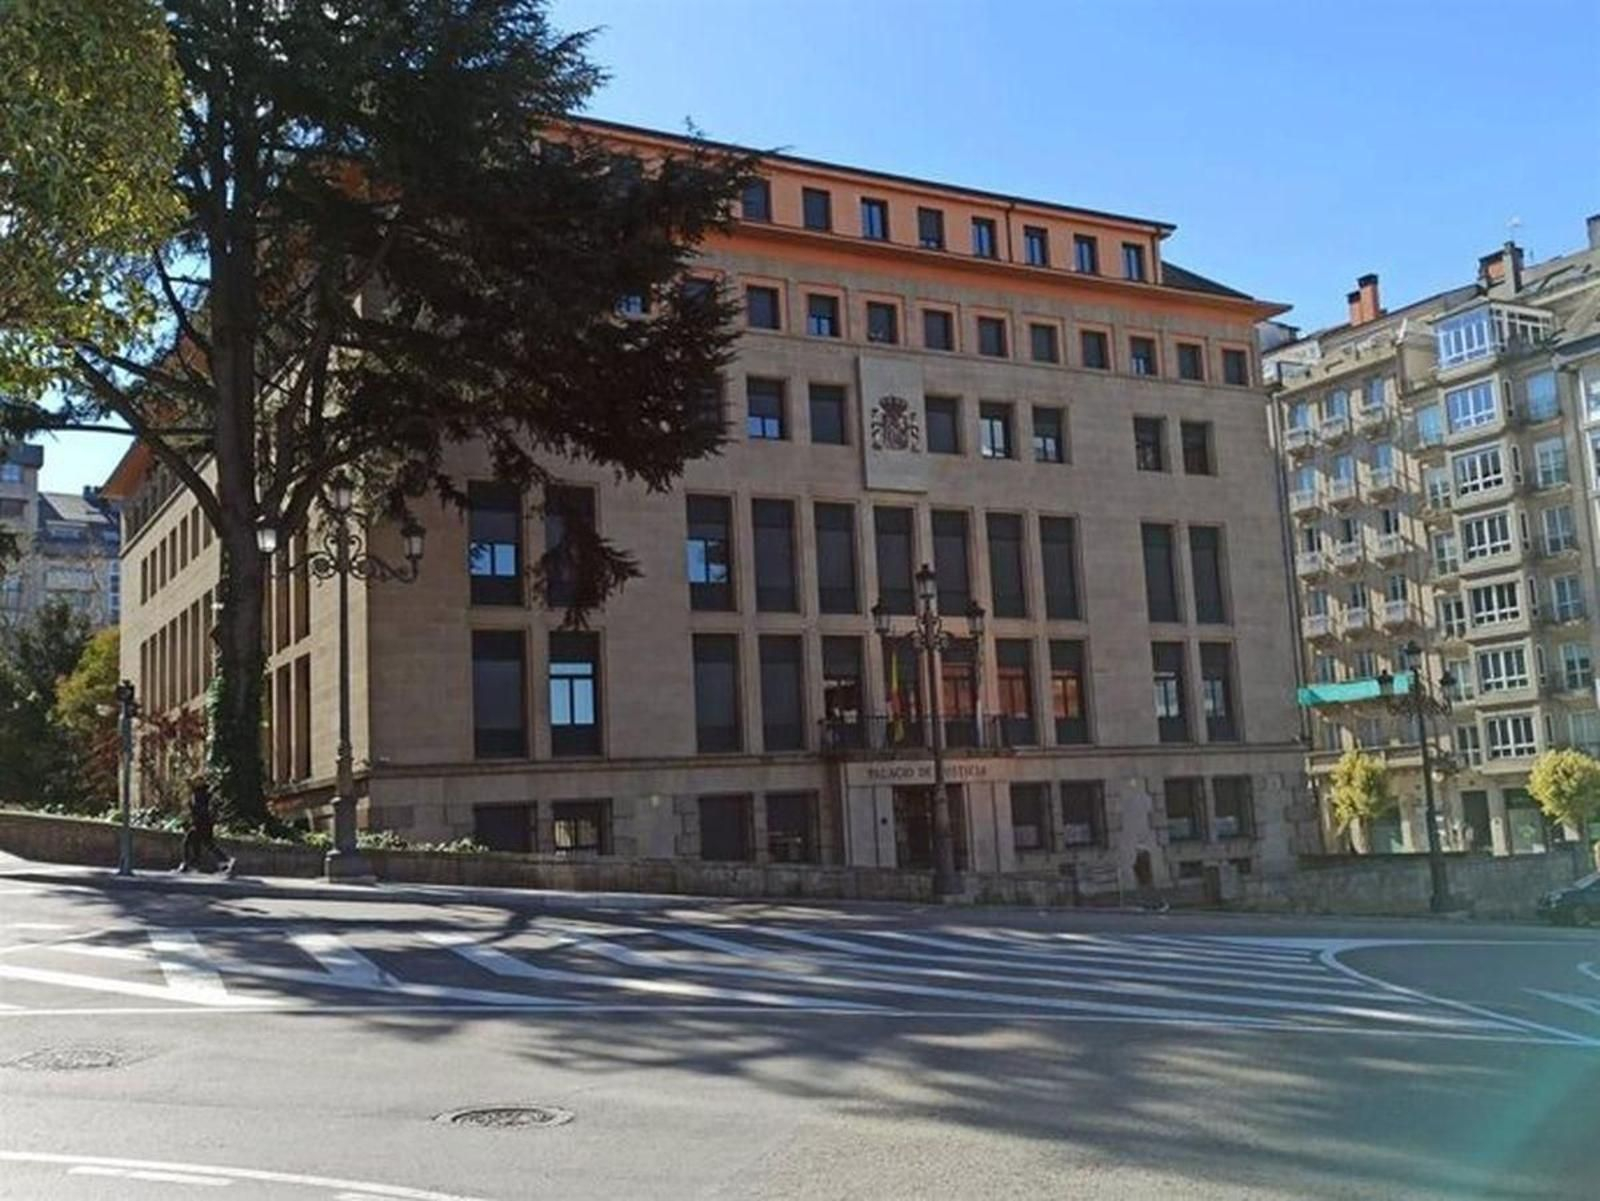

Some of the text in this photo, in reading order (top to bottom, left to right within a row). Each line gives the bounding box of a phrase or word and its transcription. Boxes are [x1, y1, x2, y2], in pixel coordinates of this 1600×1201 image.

[867, 764, 987, 779] PALACIO DE USTICIA
